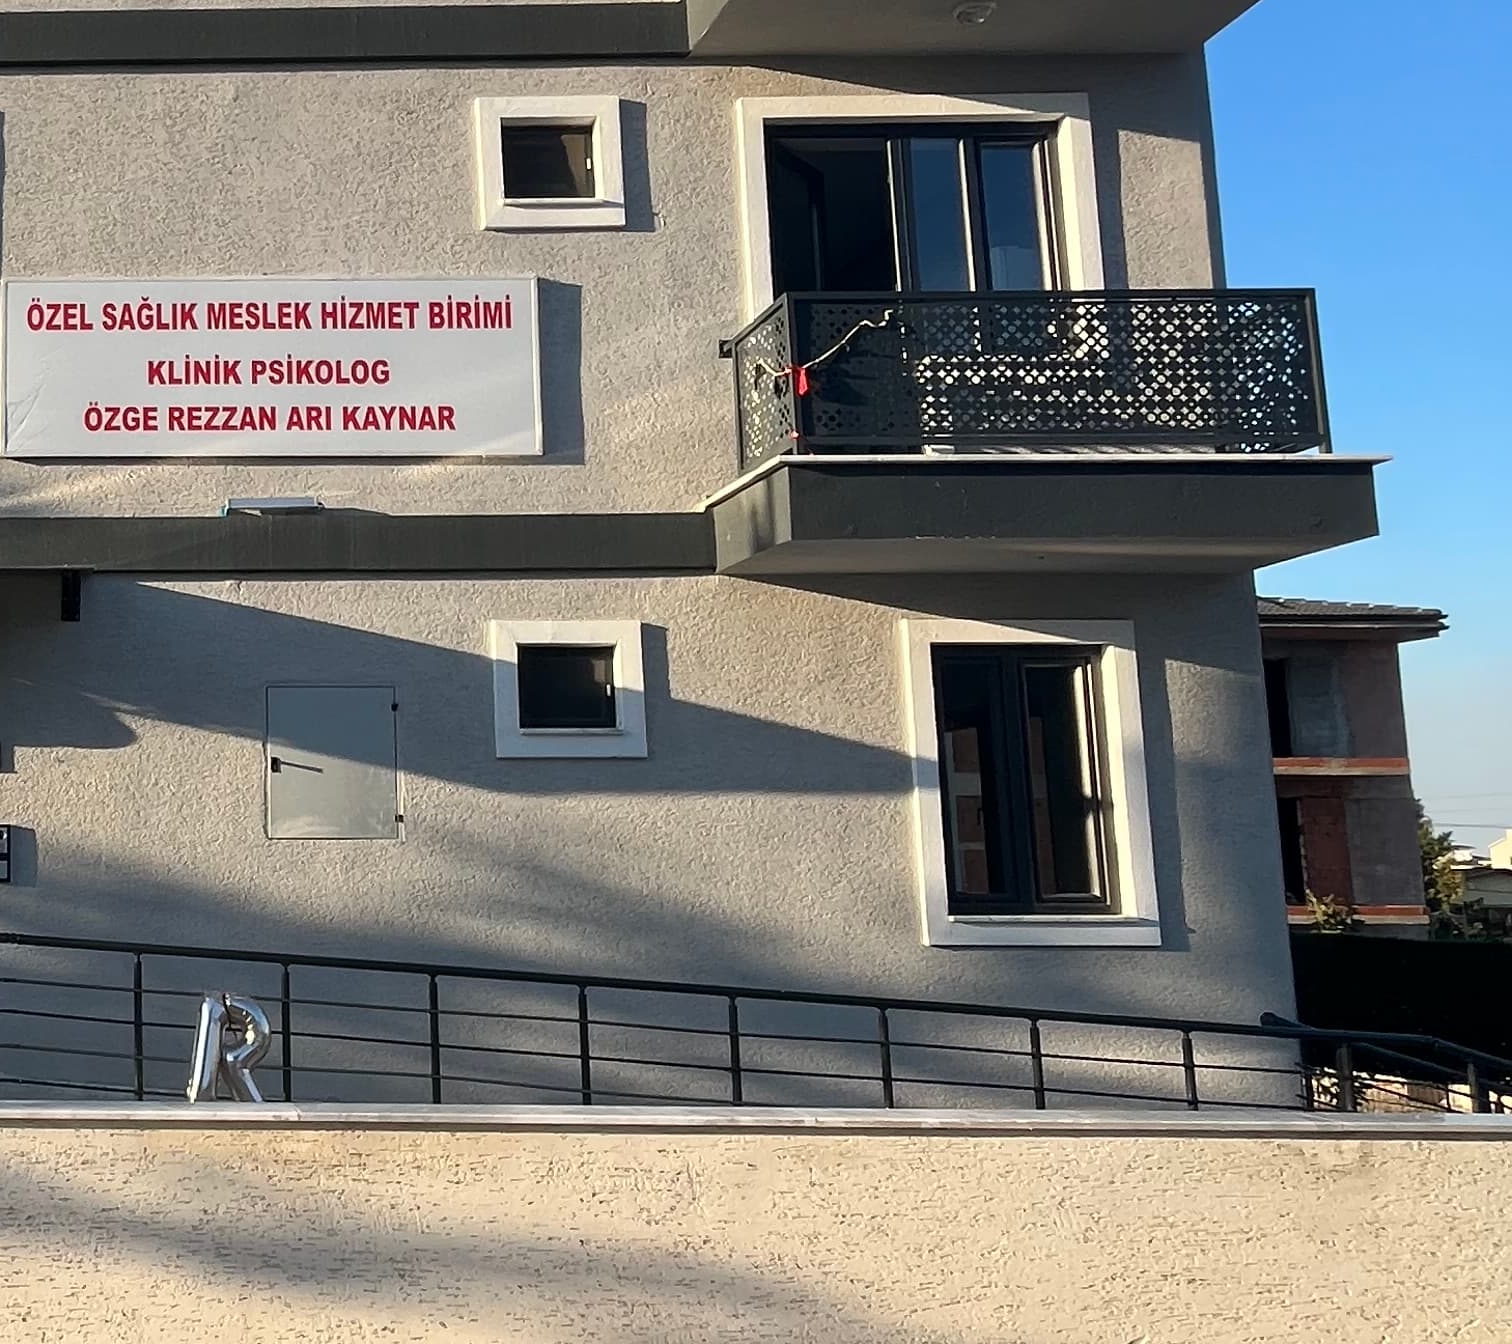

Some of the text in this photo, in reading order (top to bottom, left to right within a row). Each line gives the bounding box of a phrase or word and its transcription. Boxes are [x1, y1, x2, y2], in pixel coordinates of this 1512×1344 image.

[26, 294, 513, 332] ÖZEL SAĞLIK MESLEK HİZMET BİRİMİ
[146, 354, 391, 386] KLİNİK PSİKOLOG
[83, 403, 456, 433] ÖZGE REZZAN ARI KAYNAR
